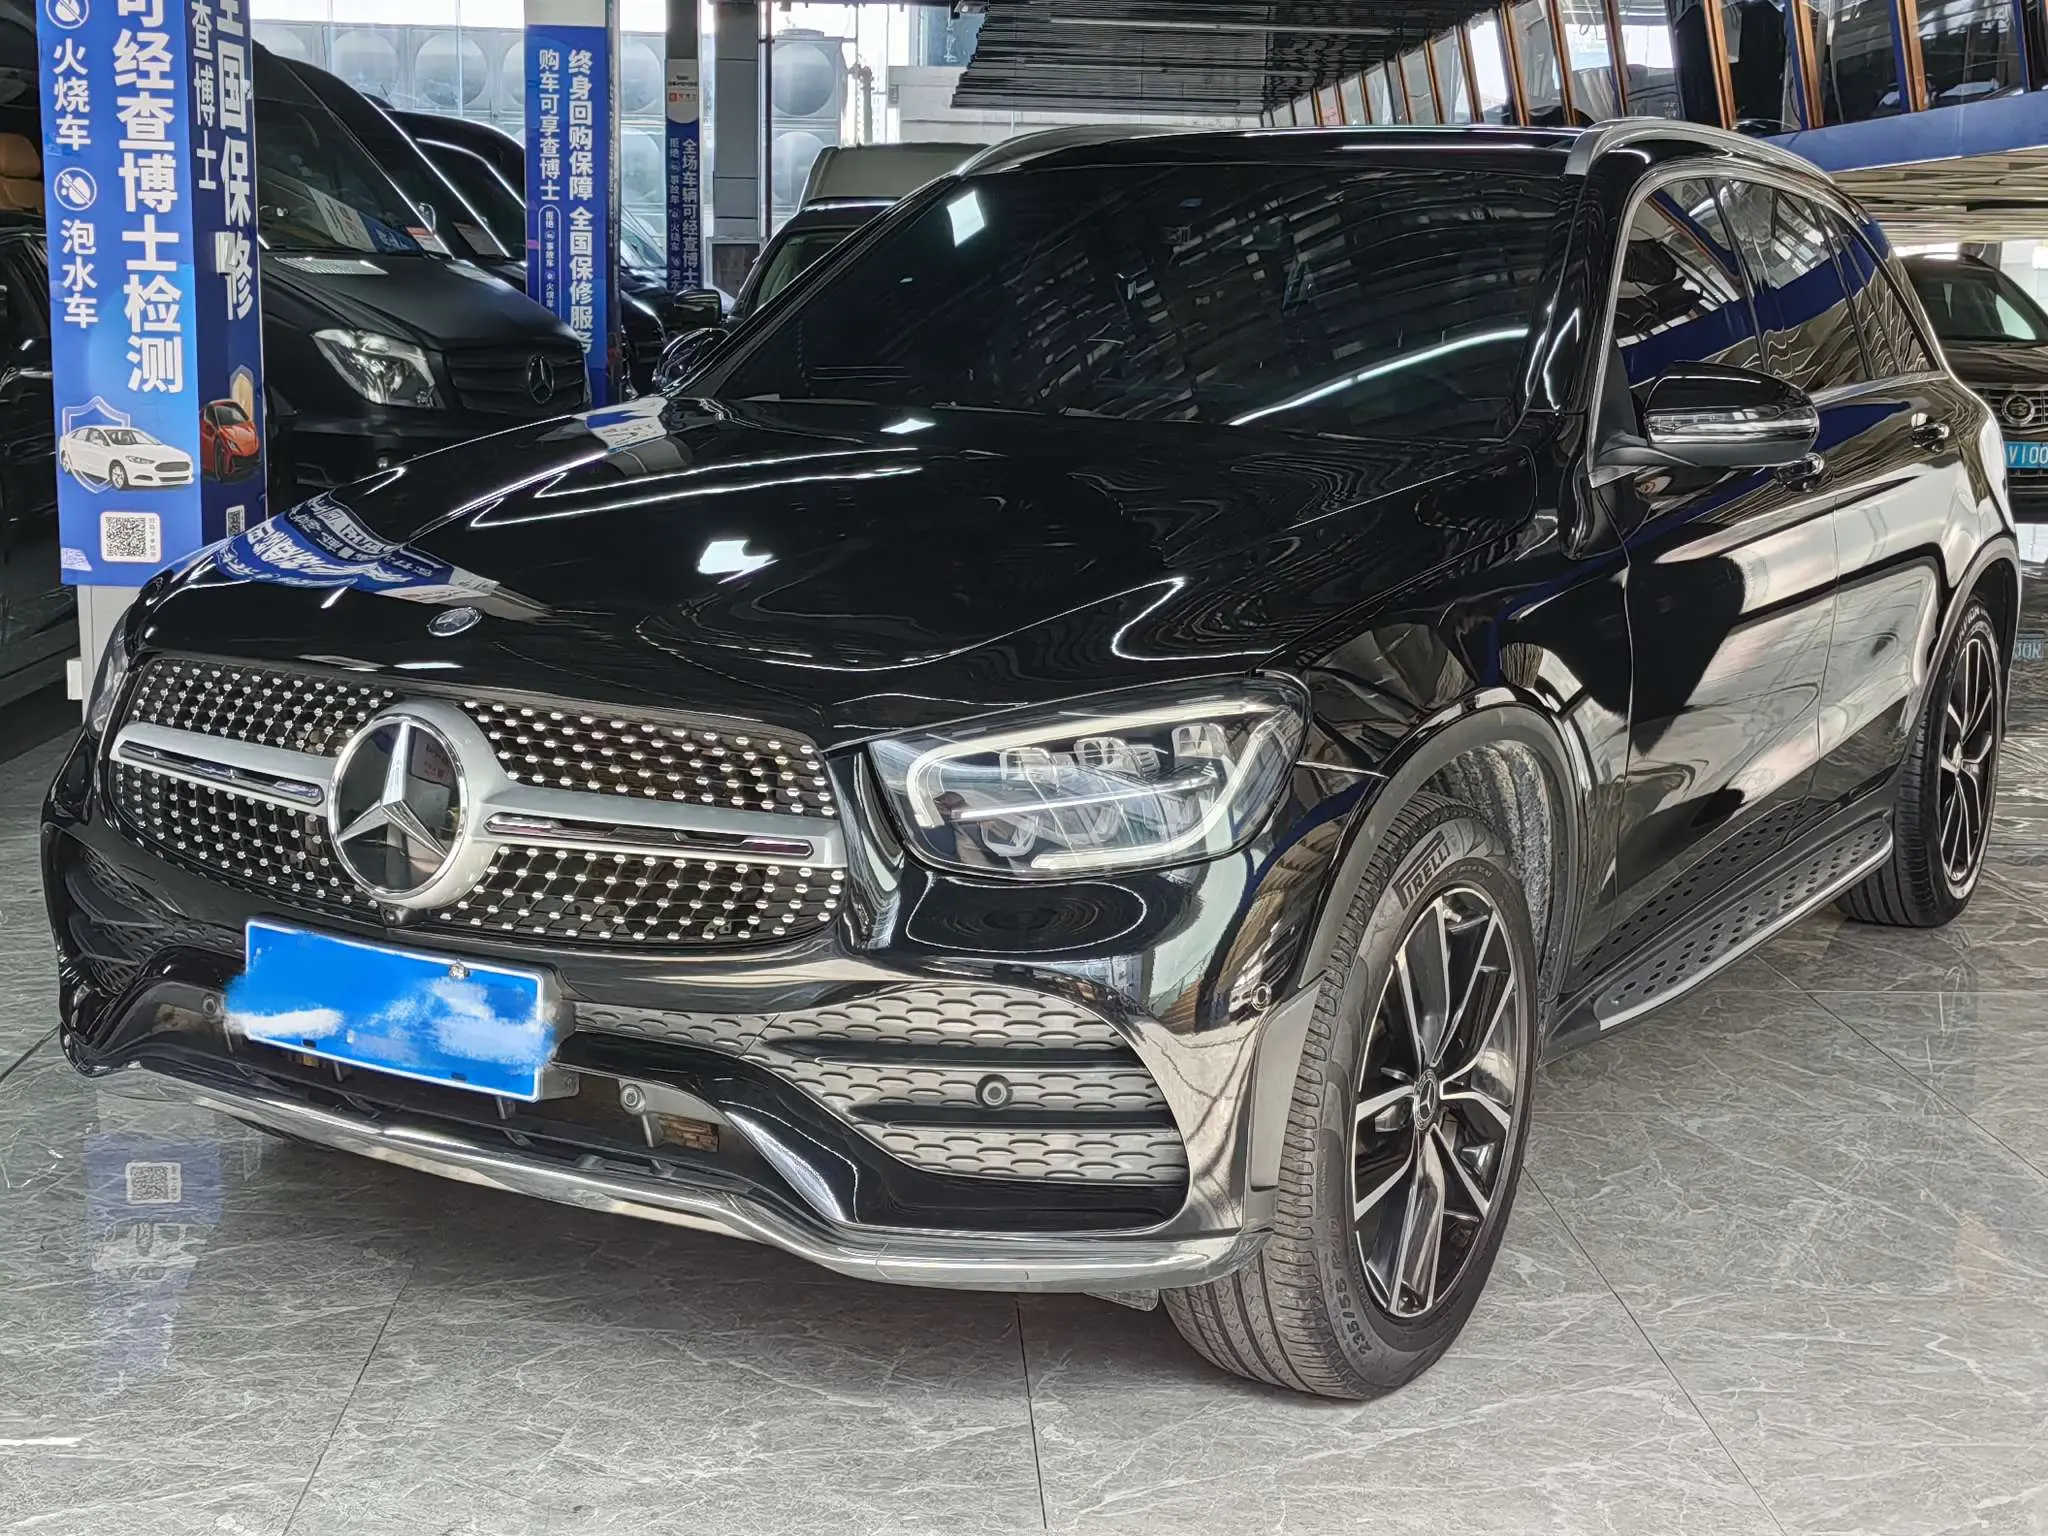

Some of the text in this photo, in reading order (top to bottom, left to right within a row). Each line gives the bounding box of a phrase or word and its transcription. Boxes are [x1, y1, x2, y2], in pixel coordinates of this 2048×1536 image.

[53, 38, 92, 151] 火烧车
[191, 0, 217, 190] 查博士
[539, 49, 561, 201] 购车可享查博士
[568, 50, 594, 354] 终身回购保障 全国保修服务
[60, 219, 98, 329] 泡水车
[1392, 830, 1452, 911] PIRELLI
